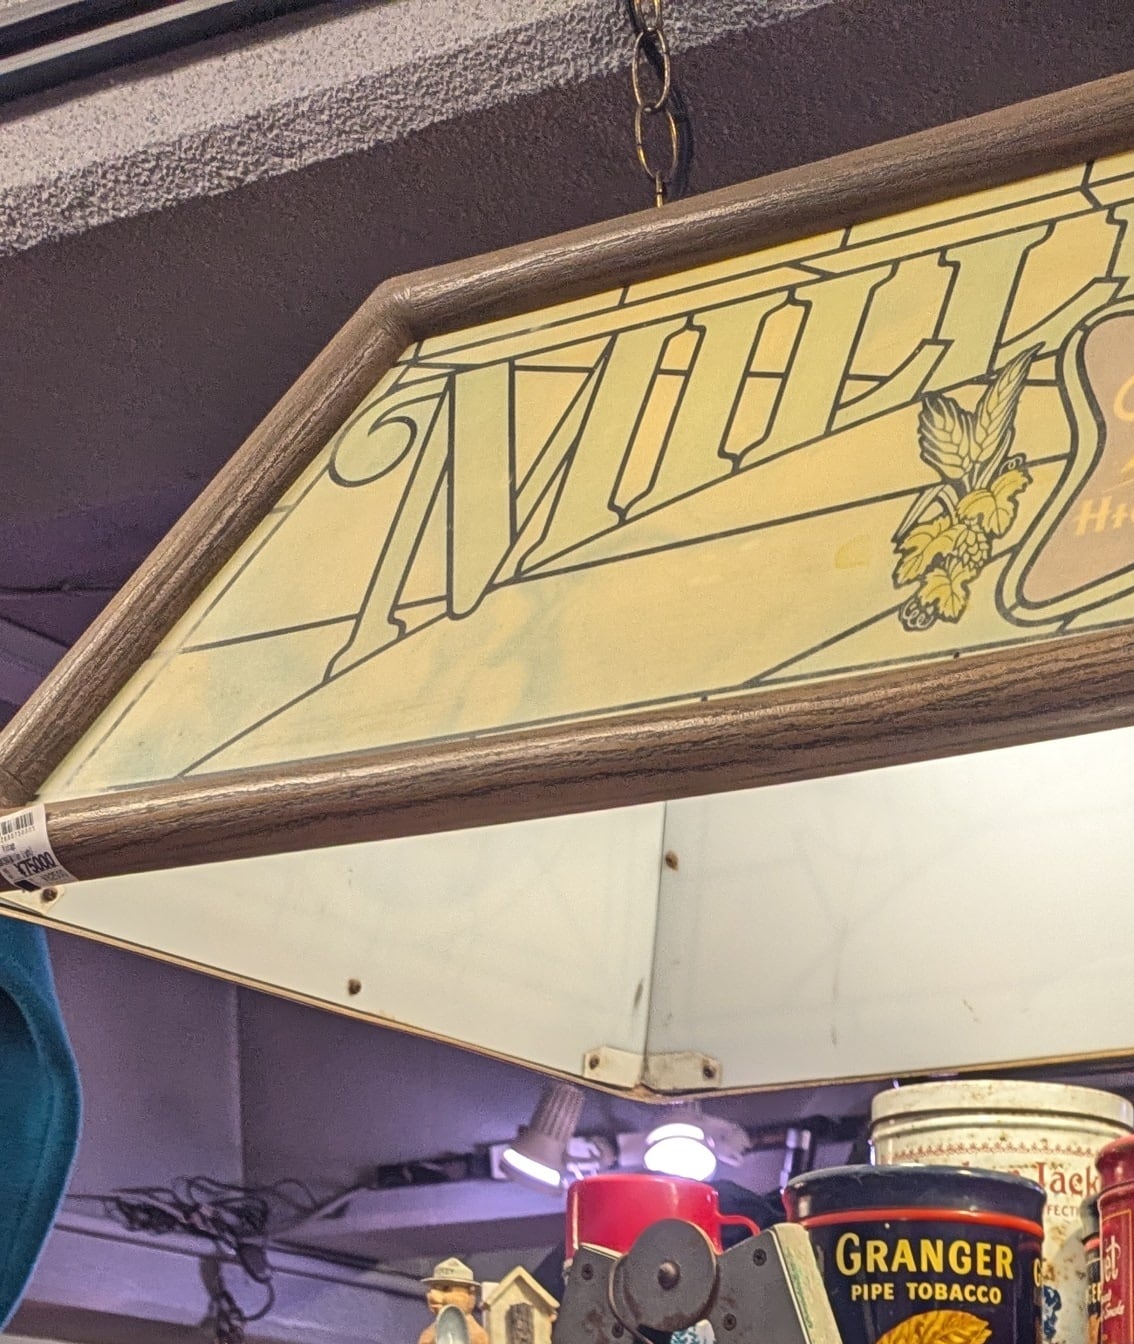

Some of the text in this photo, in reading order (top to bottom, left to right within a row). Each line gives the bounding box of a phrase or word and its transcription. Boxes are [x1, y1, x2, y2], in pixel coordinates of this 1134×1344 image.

[835, 1232, 1014, 1280] GRANGER
[851, 1282, 1002, 1304] PIPE TOBACCO
